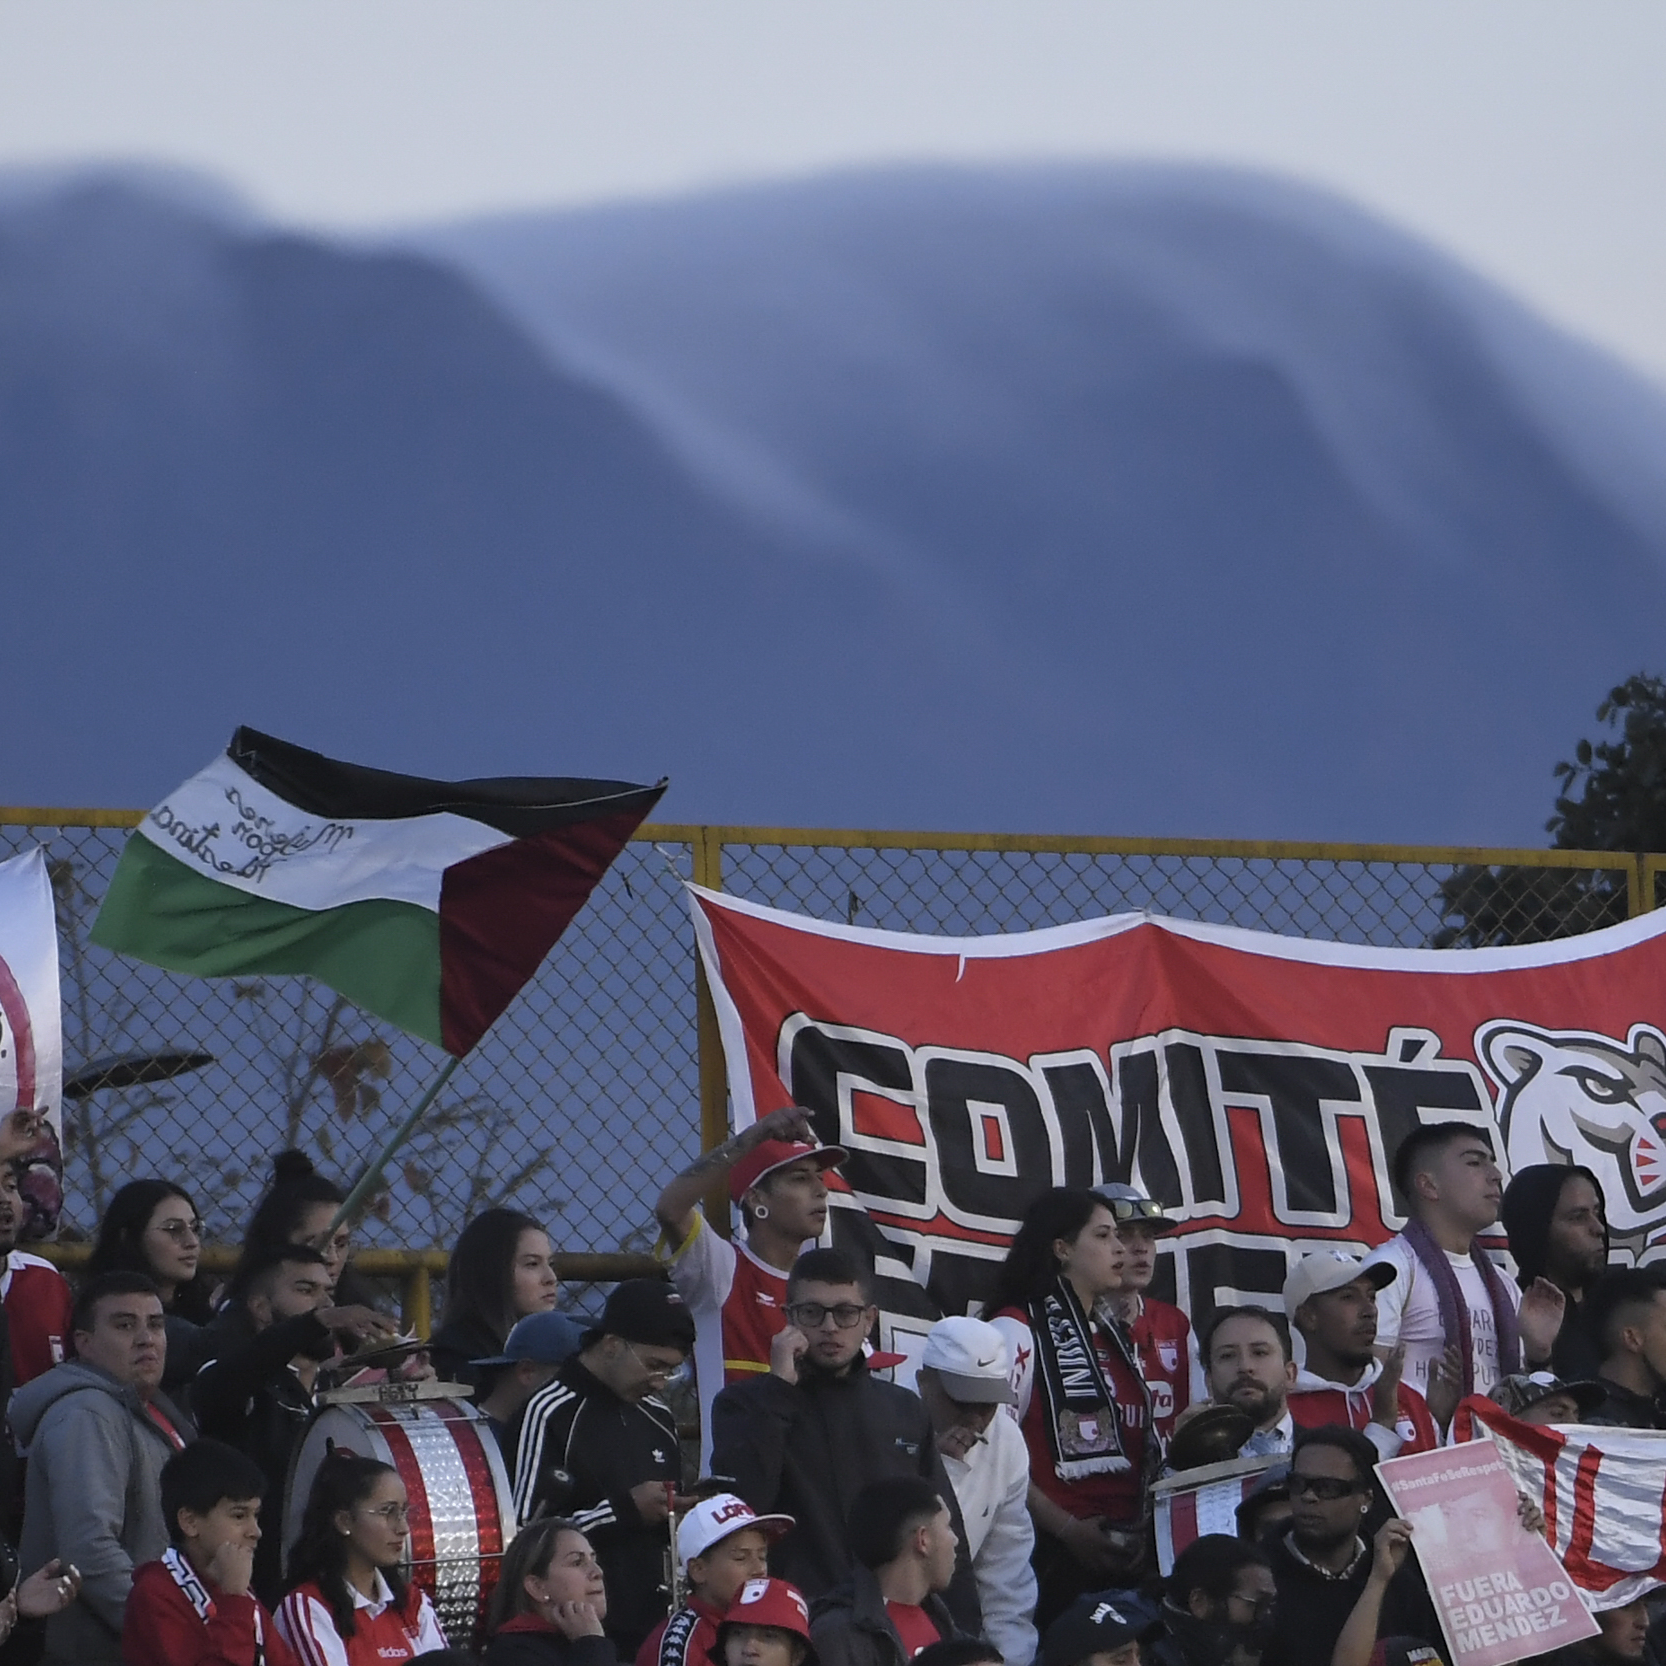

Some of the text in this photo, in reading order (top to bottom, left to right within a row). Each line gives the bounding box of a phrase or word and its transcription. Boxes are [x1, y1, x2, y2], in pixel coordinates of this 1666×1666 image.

[779, 1026, 1493, 1240] COMITÉ
[1441, 1571, 1523, 1607] FUERA
[1448, 1582, 1571, 1628] EDUARDO
[1455, 1607, 1568, 1653] MENDEZ
